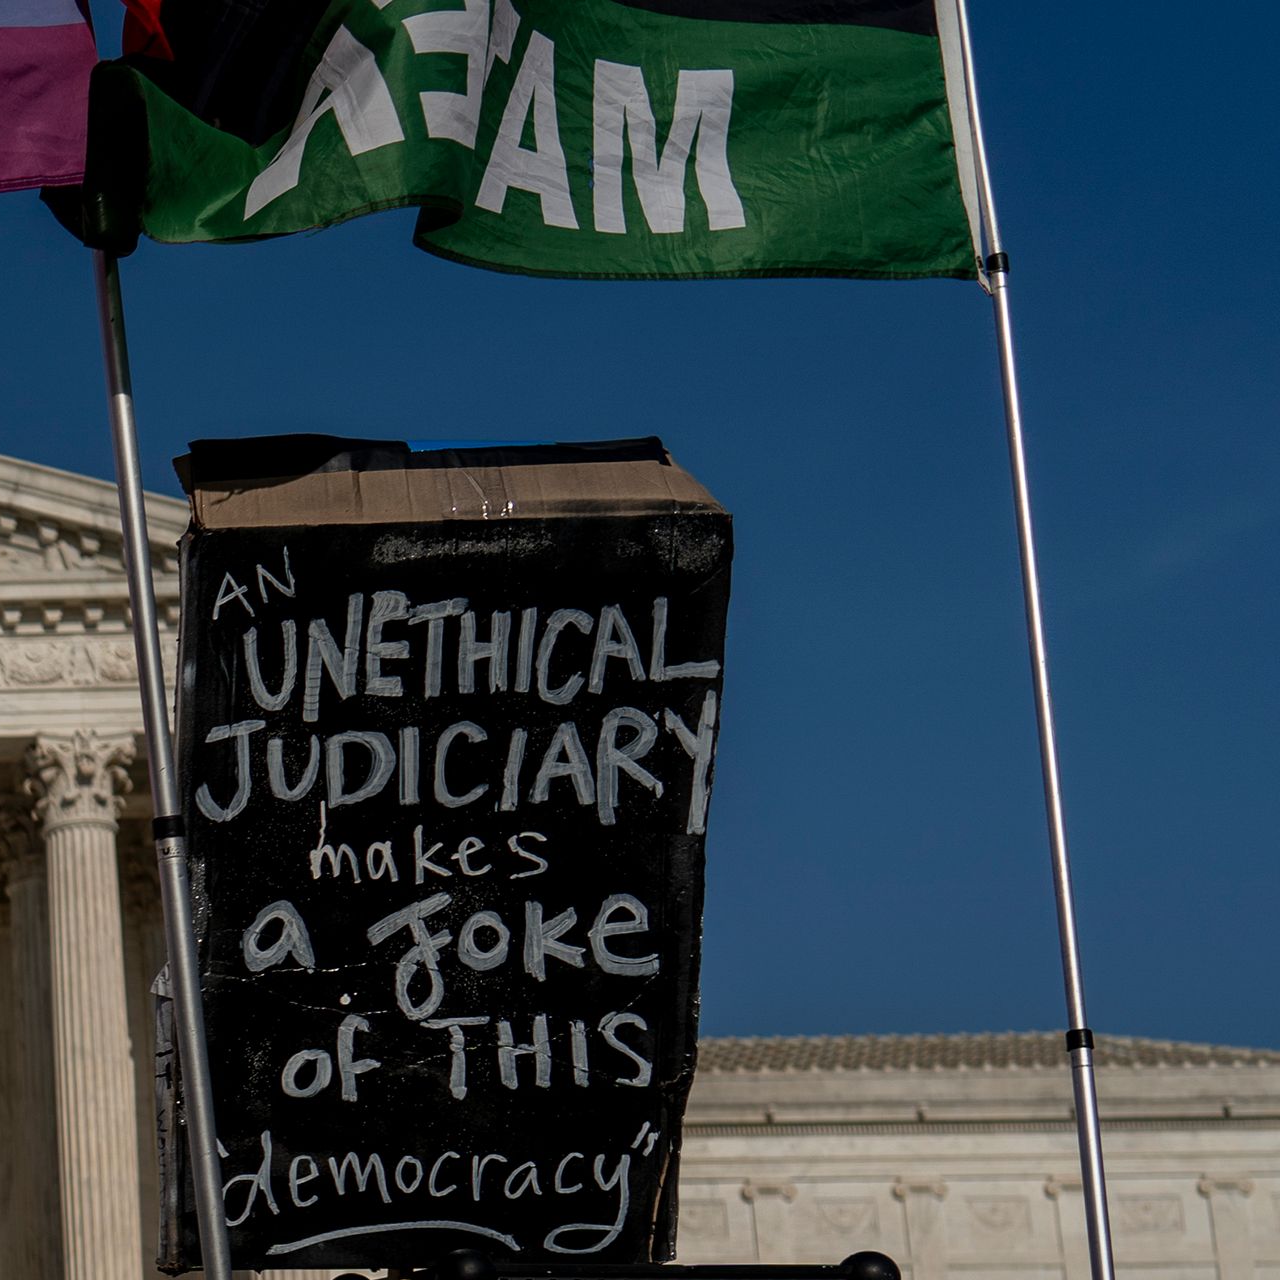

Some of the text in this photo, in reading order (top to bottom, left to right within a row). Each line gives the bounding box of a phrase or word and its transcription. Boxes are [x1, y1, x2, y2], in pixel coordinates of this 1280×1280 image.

[211, 545, 297, 622] AN
[242, 589, 723, 724] UNETHICAL
[195, 690, 718, 836] JUDICIARY
[308, 799, 550, 883] makes
[242, 899, 316, 976] a
[281, 1010, 654, 1103] of THIS
